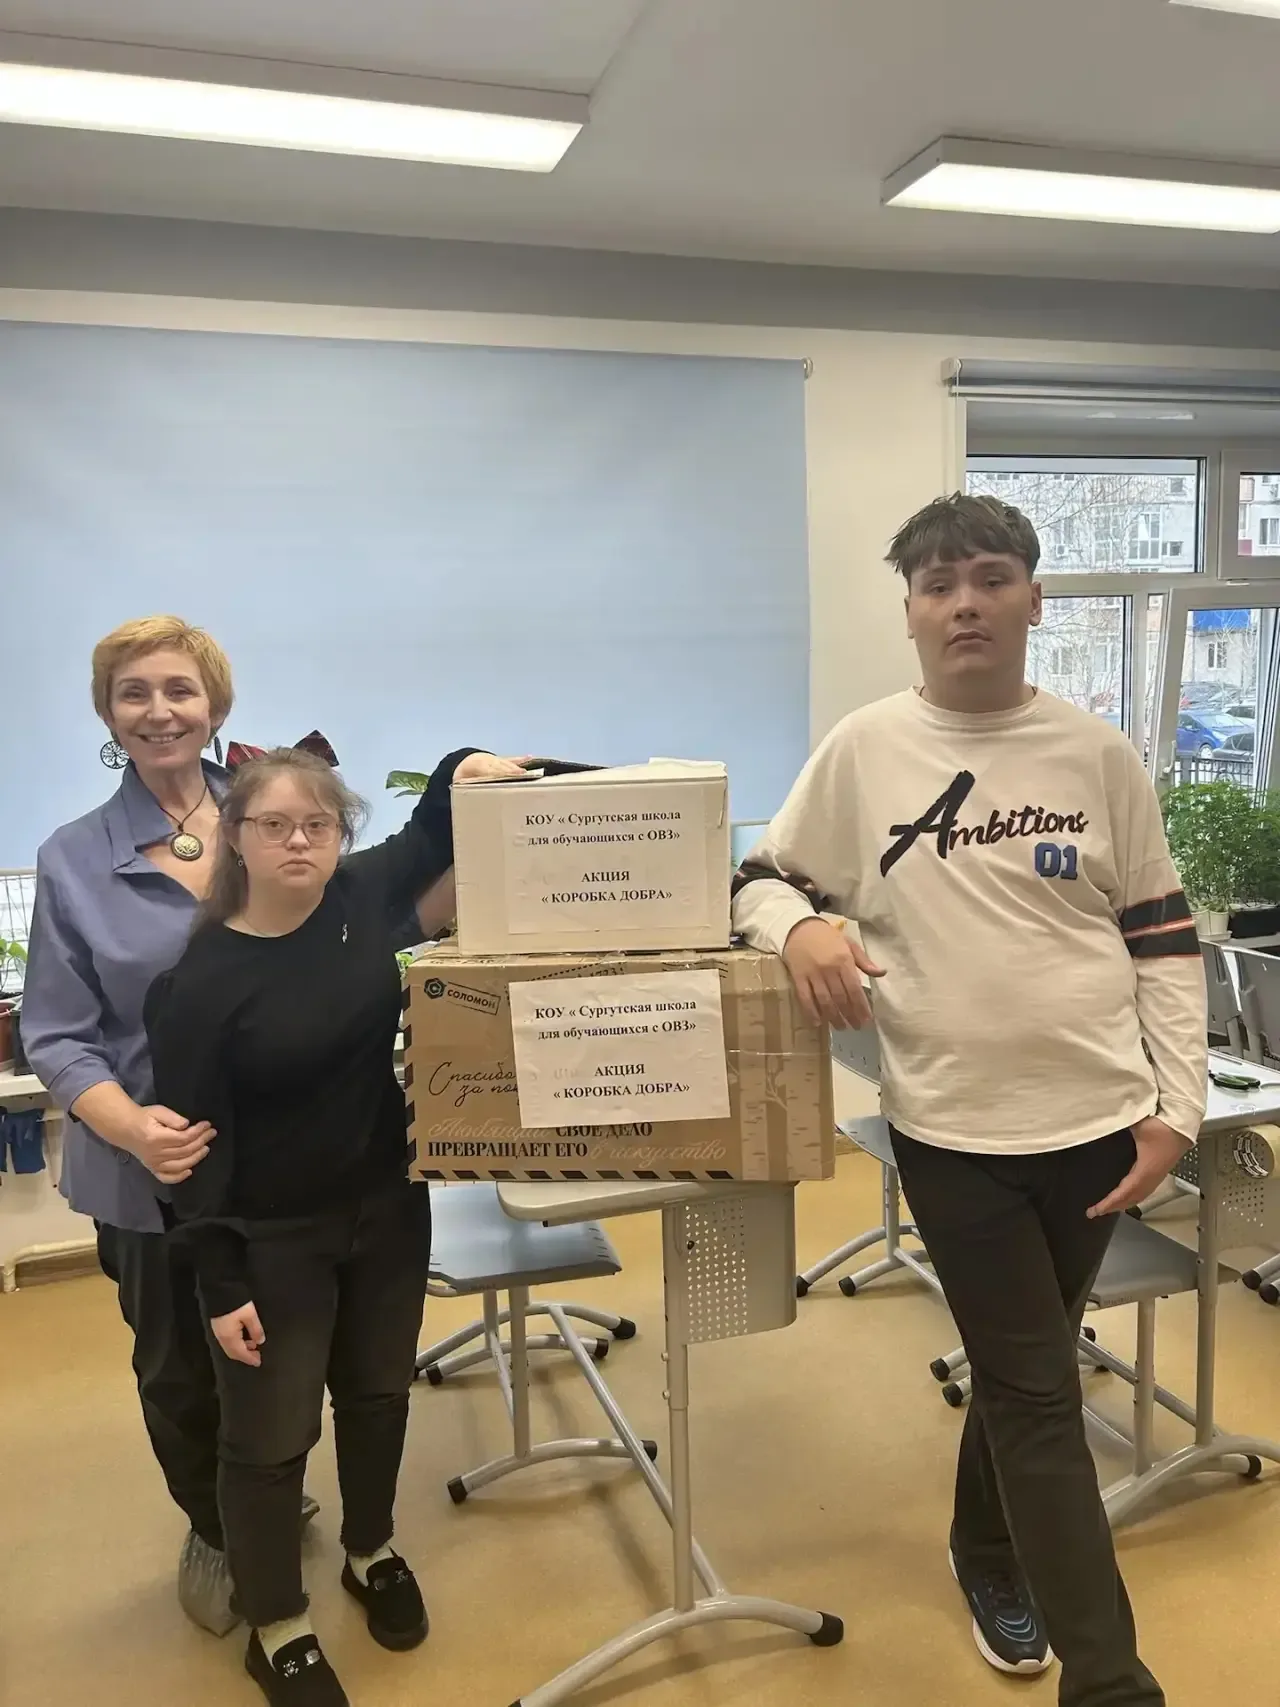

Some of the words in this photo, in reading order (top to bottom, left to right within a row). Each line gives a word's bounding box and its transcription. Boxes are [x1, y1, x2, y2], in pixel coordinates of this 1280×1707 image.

[525, 814, 554, 826] КОУ
[568, 812, 638, 827] Сургутская
[641, 810, 681, 822] школа
[880, 770, 1089, 878] Ambitions
[527, 834, 549, 846] для
[552, 831, 636, 847] обучающихся
[638, 833, 644, 841] с
[1034, 841, 1078, 880] 01
[581, 870, 630, 884] АКЦИЯ
[551, 890, 616, 904] КОРОБКА
[447, 989, 496, 1009] СОЛОМОН
[535, 1006, 565, 1019] КОУ
[579, 1003, 652, 1018] Сургутская
[655, 1000, 697, 1012] школа
[537, 1029, 560, 1040] для
[563, 1023, 649, 1039] обучающихся
[652, 1024, 659, 1033] с
[428, 1061, 516, 1096] Спасибо
[594, 1063, 645, 1077] АКЦИЯ
[454, 1084, 484, 1108] за
[564, 1085, 631, 1099] КОРОБКА
[605, 1122, 653, 1139] ДЕЛО
[428, 1142, 552, 1159] ПРЕВРАЩАЕТ
[555, 1143, 588, 1157] ЕГО
